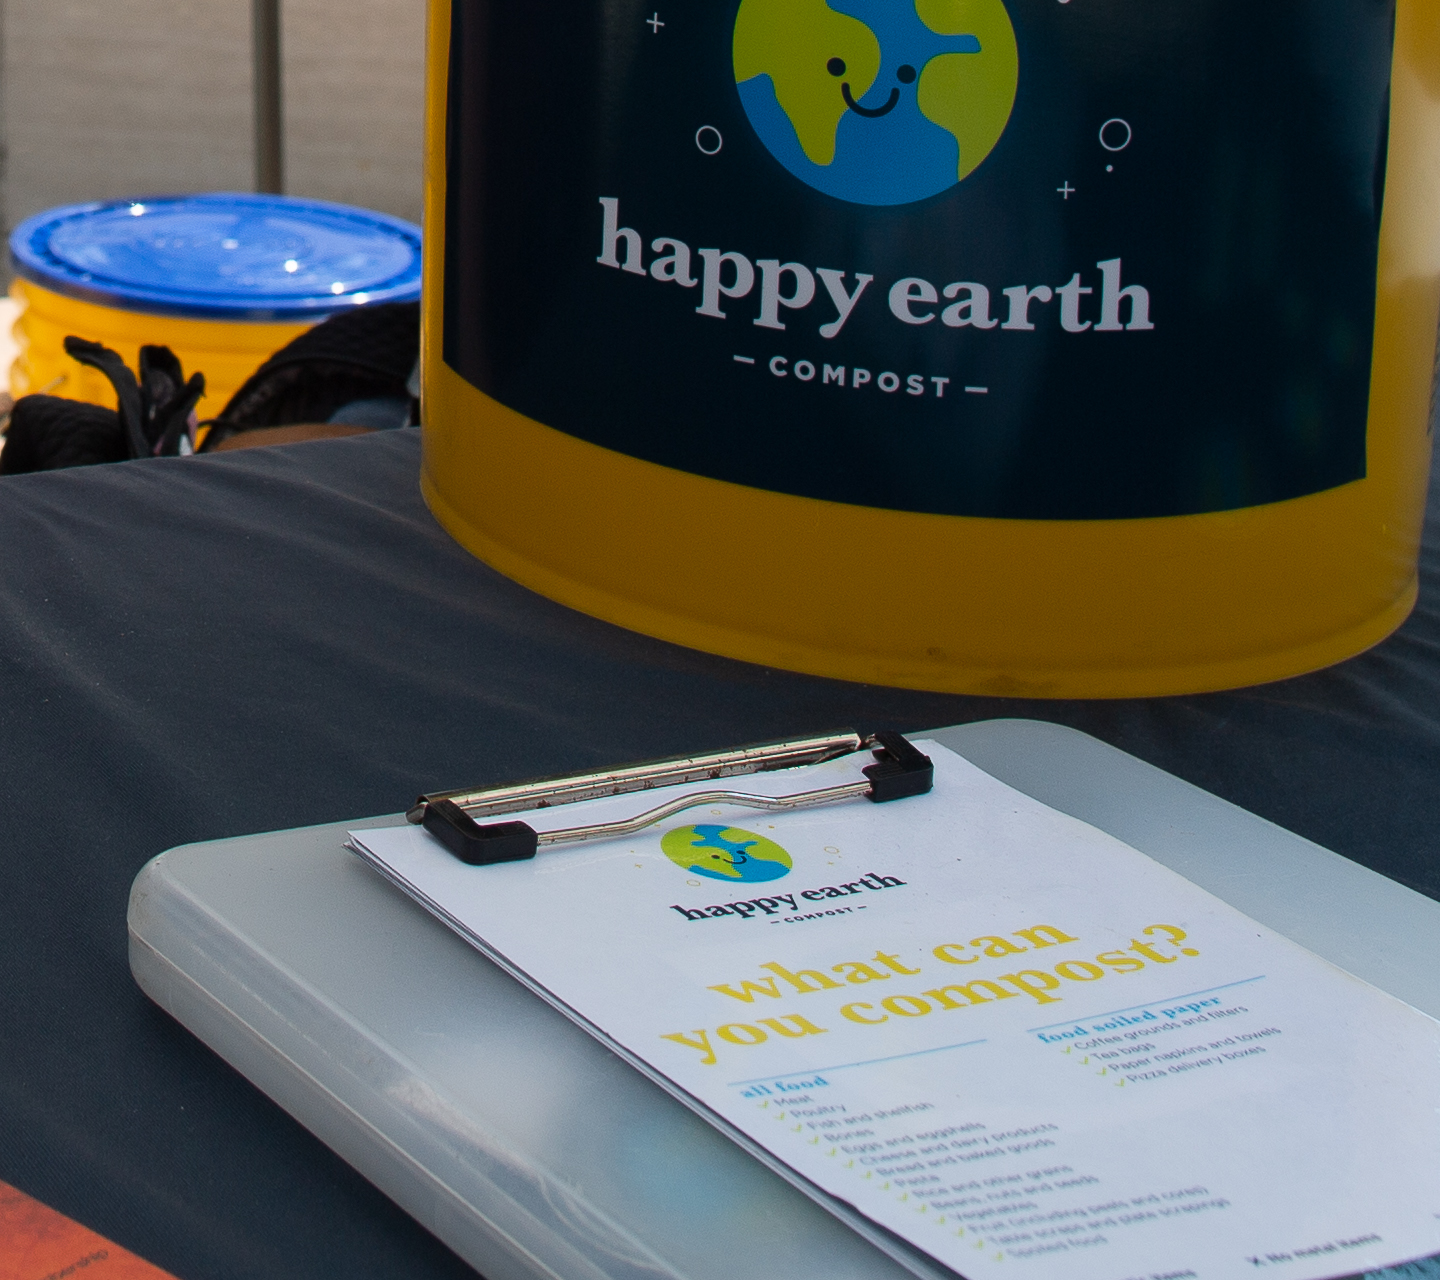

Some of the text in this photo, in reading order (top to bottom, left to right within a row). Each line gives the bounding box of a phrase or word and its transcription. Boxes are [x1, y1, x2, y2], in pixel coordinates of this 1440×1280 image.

[595, 197, 1156, 339] happy earth
[768, 354, 952, 400] COMPOST
[670, 871, 908, 921] happy earth
[783, 906, 854, 923] COMPOST
[707, 923, 1080, 1004] what can
[660, 923, 1201, 1066] you compost?
[1036, 997, 1221, 1044] food soiled paper
[1181, 1013, 1210, 1027] and
[740, 1075, 830, 1099] all food
